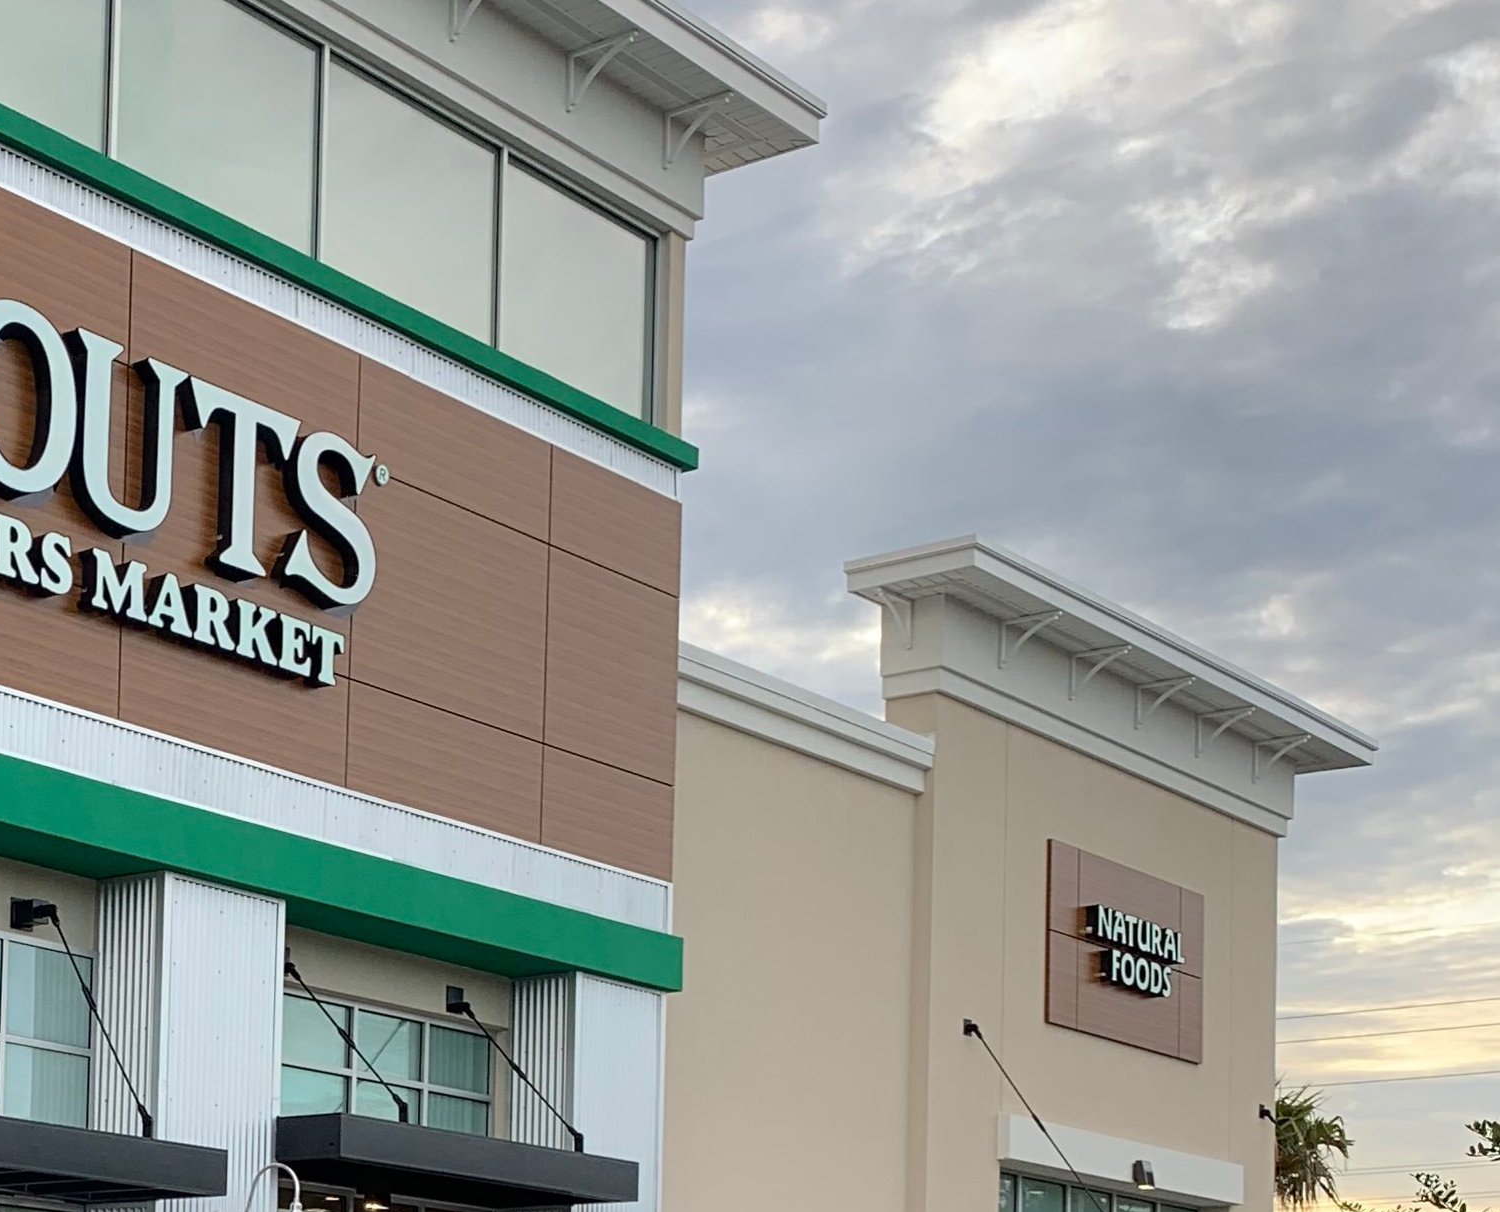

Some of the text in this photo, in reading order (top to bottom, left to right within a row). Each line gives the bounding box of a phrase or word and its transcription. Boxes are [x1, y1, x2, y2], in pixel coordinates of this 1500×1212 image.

[91, 547, 345, 687] MARKET
[1097, 904, 1185, 964] NATURAL
[1112, 949, 1172, 998] FOODS
